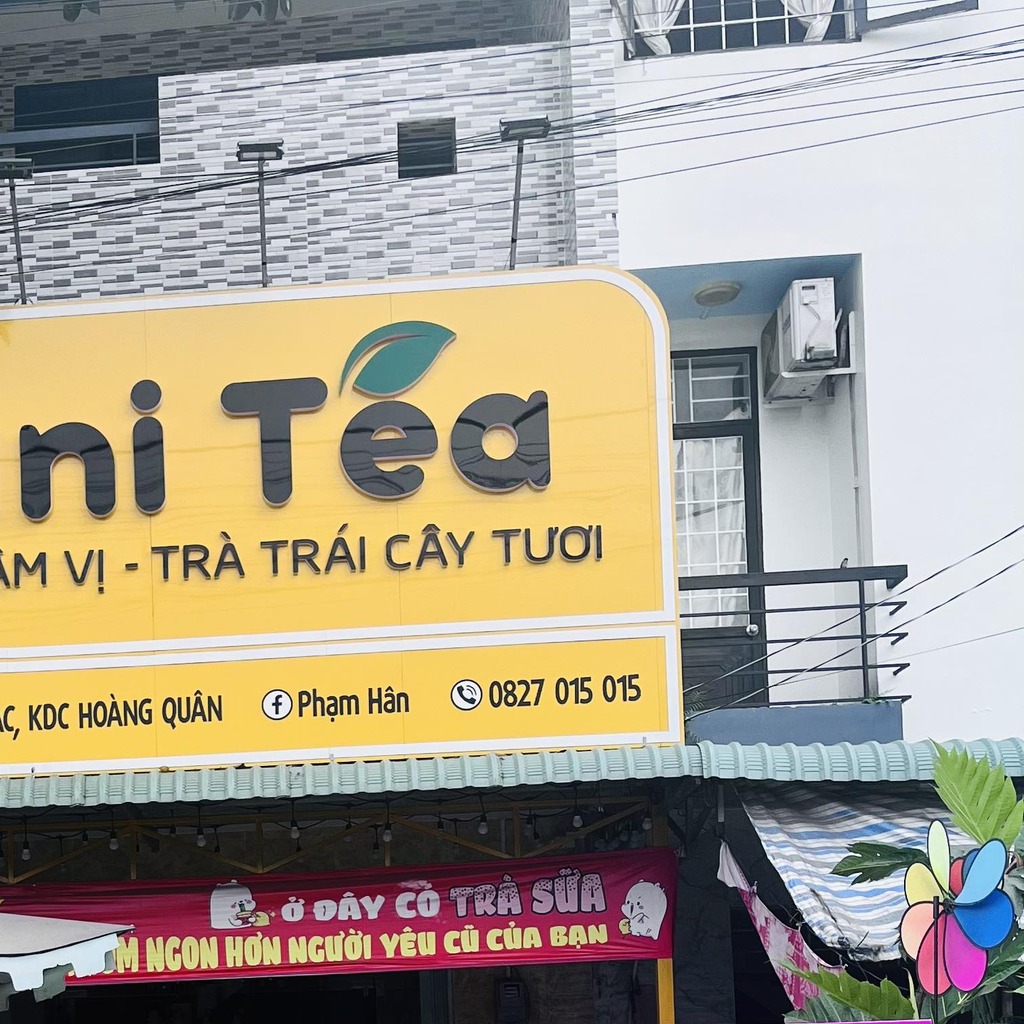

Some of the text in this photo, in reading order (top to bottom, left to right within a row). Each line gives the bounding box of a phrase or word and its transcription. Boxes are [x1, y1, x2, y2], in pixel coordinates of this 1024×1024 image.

[64, 549, 104, 594] VỊ
[151, 531, 245, 581] TRÀ
[260, 523, 366, 576] TRÁI
[385, 523, 475, 571] CÂY
[492, 524, 603, 566] TƯƠI
[28, 702, 70, 731] KDC
[78, 693, 152, 729] HOÀNG
[162, 689, 223, 730] QUÂN
[298, 688, 361, 723] Phạm
[368, 686, 410, 715] Hân
[489, 674, 641, 708] 0827 015 015
[313, 891, 385, 922] ĐÂY
[449, 873, 523, 918] TRÀ
[531, 865, 607, 915] SỮA
[146, 936, 219, 973] NGON
[225, 931, 282, 968] HƠN
[288, 928, 372, 964] NGƯỜI
[378, 926, 437, 959] YÊU
[443, 924, 479, 954] CŨ
[486, 921, 543, 951] CỦA
[550, 924, 608, 950] BẠN
